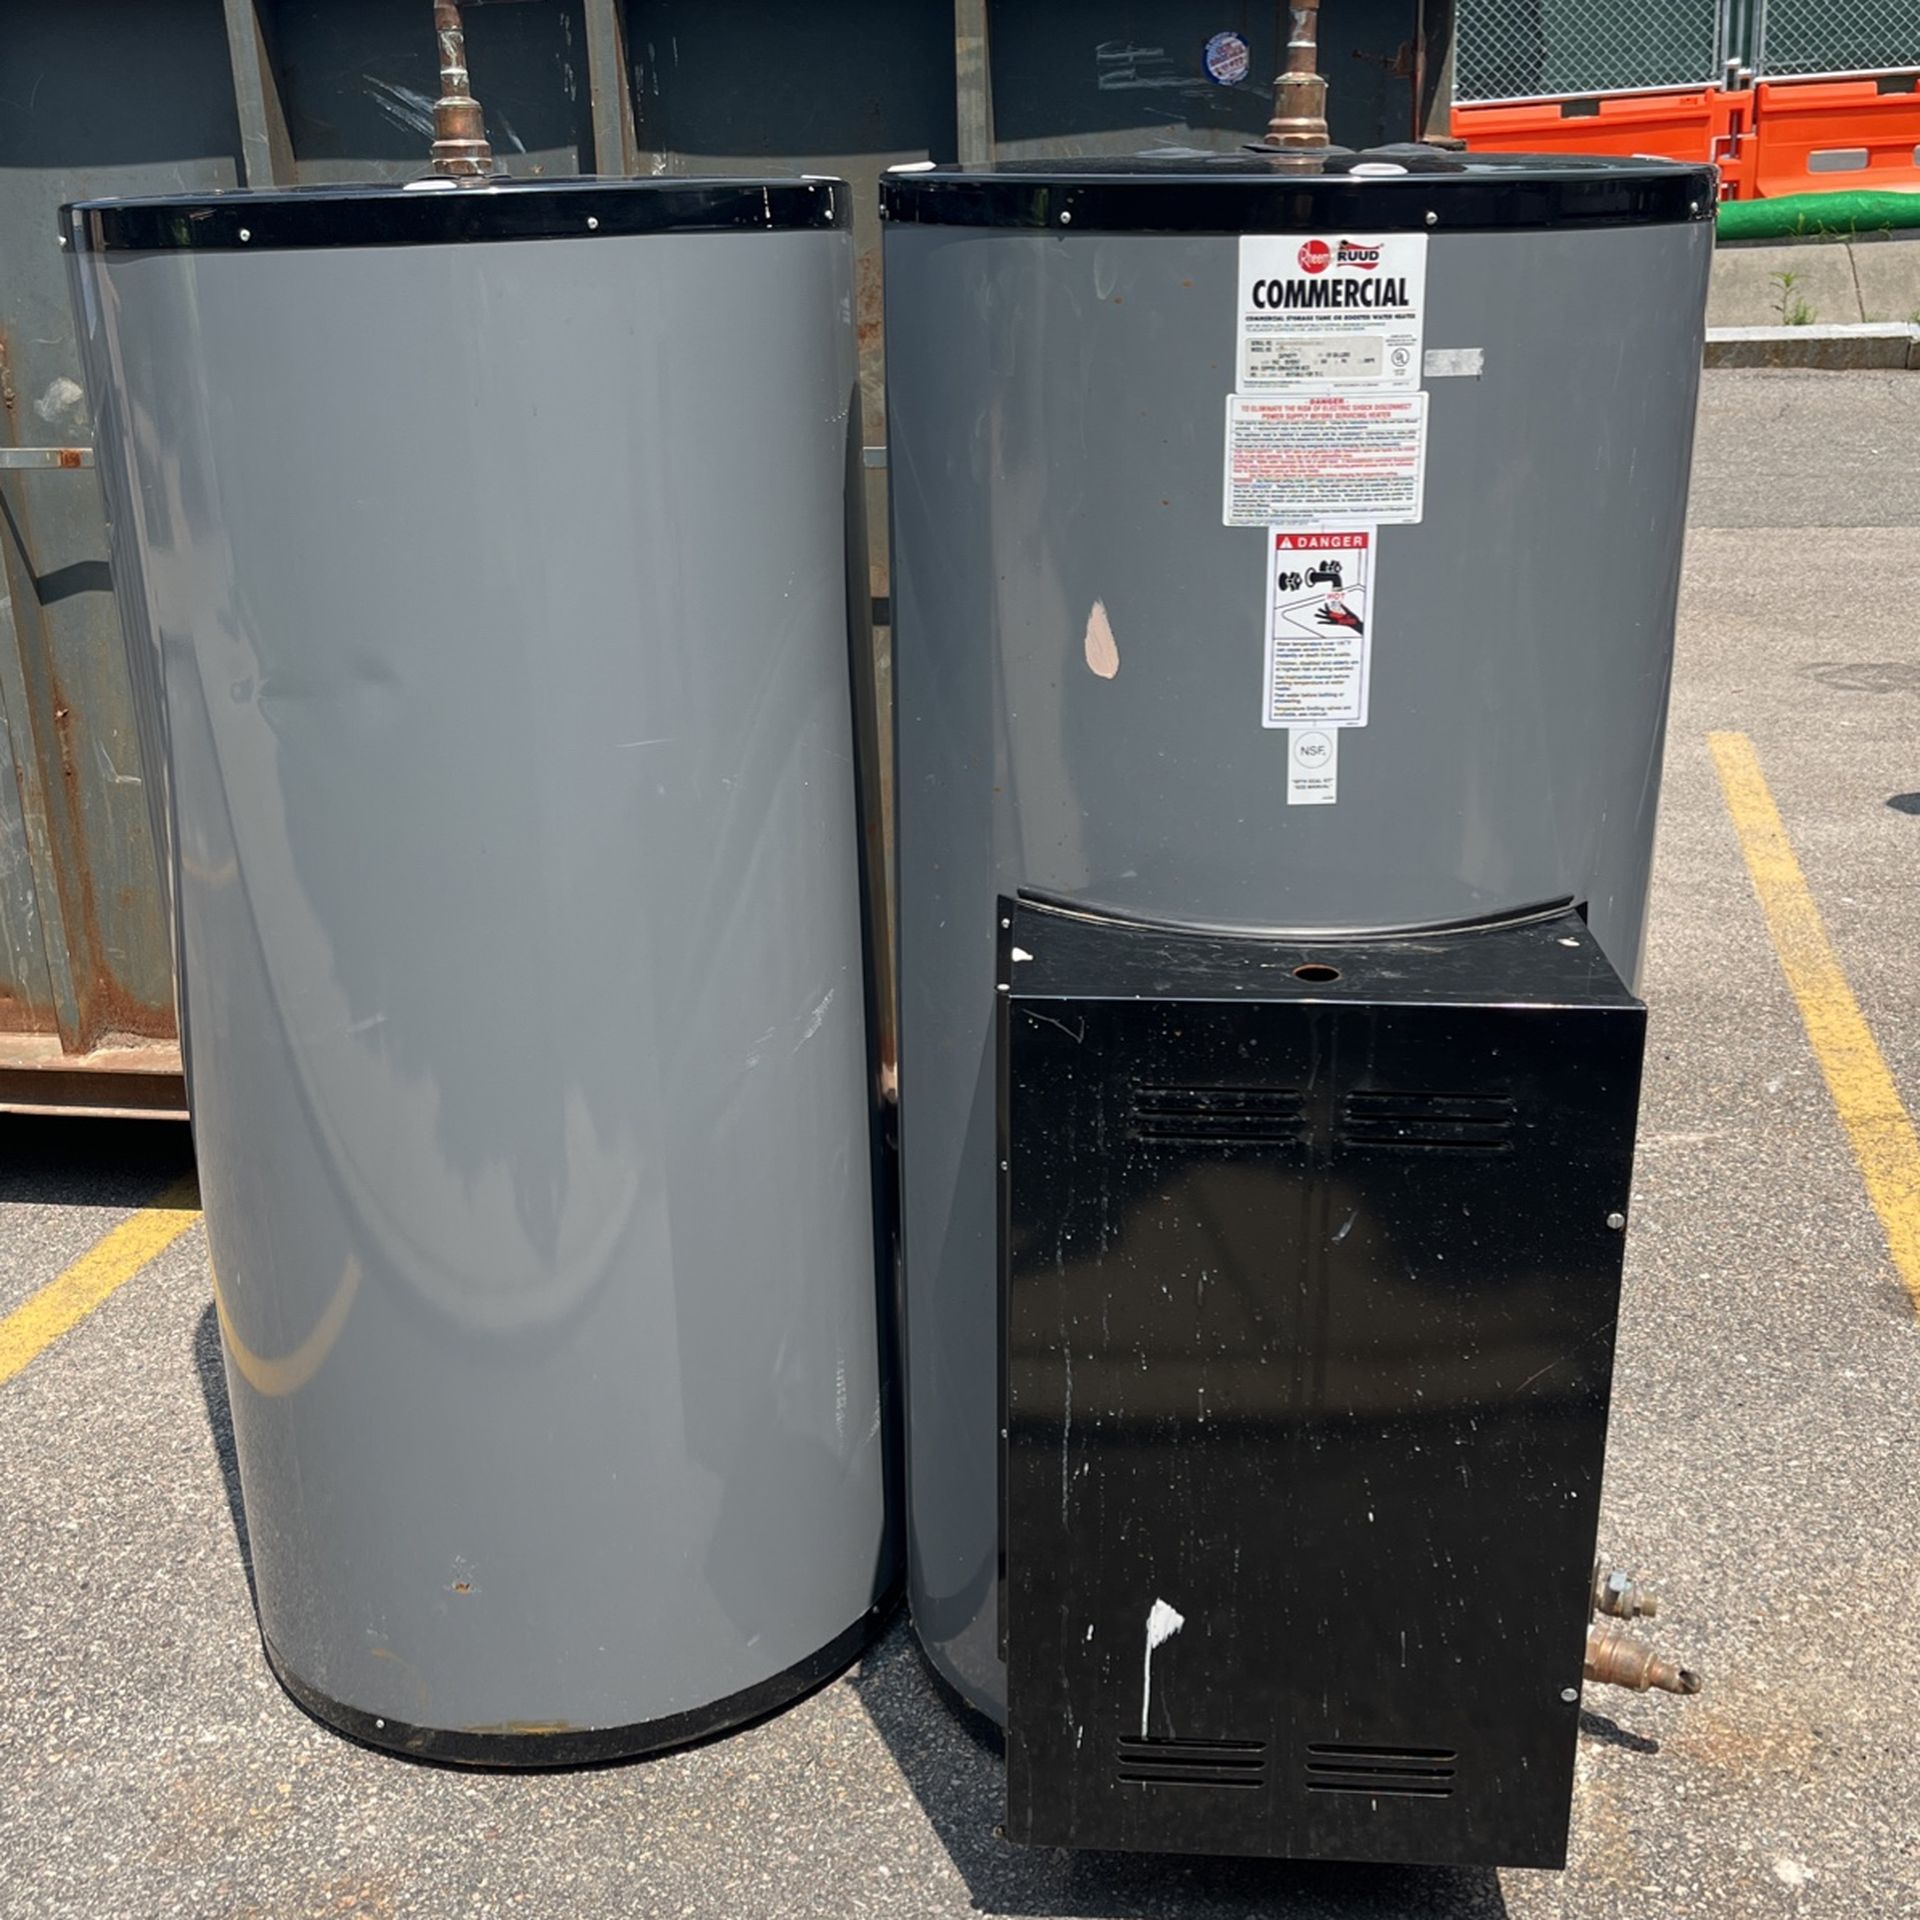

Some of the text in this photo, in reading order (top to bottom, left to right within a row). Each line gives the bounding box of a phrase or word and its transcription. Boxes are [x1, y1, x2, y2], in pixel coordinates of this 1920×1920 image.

[1299, 242, 1379, 268] Rheem RUUD
[1253, 278, 1409, 309] COMMERCIAL
[1298, 536, 1362, 547] DANGER
[1300, 746, 1325, 756] NSF
